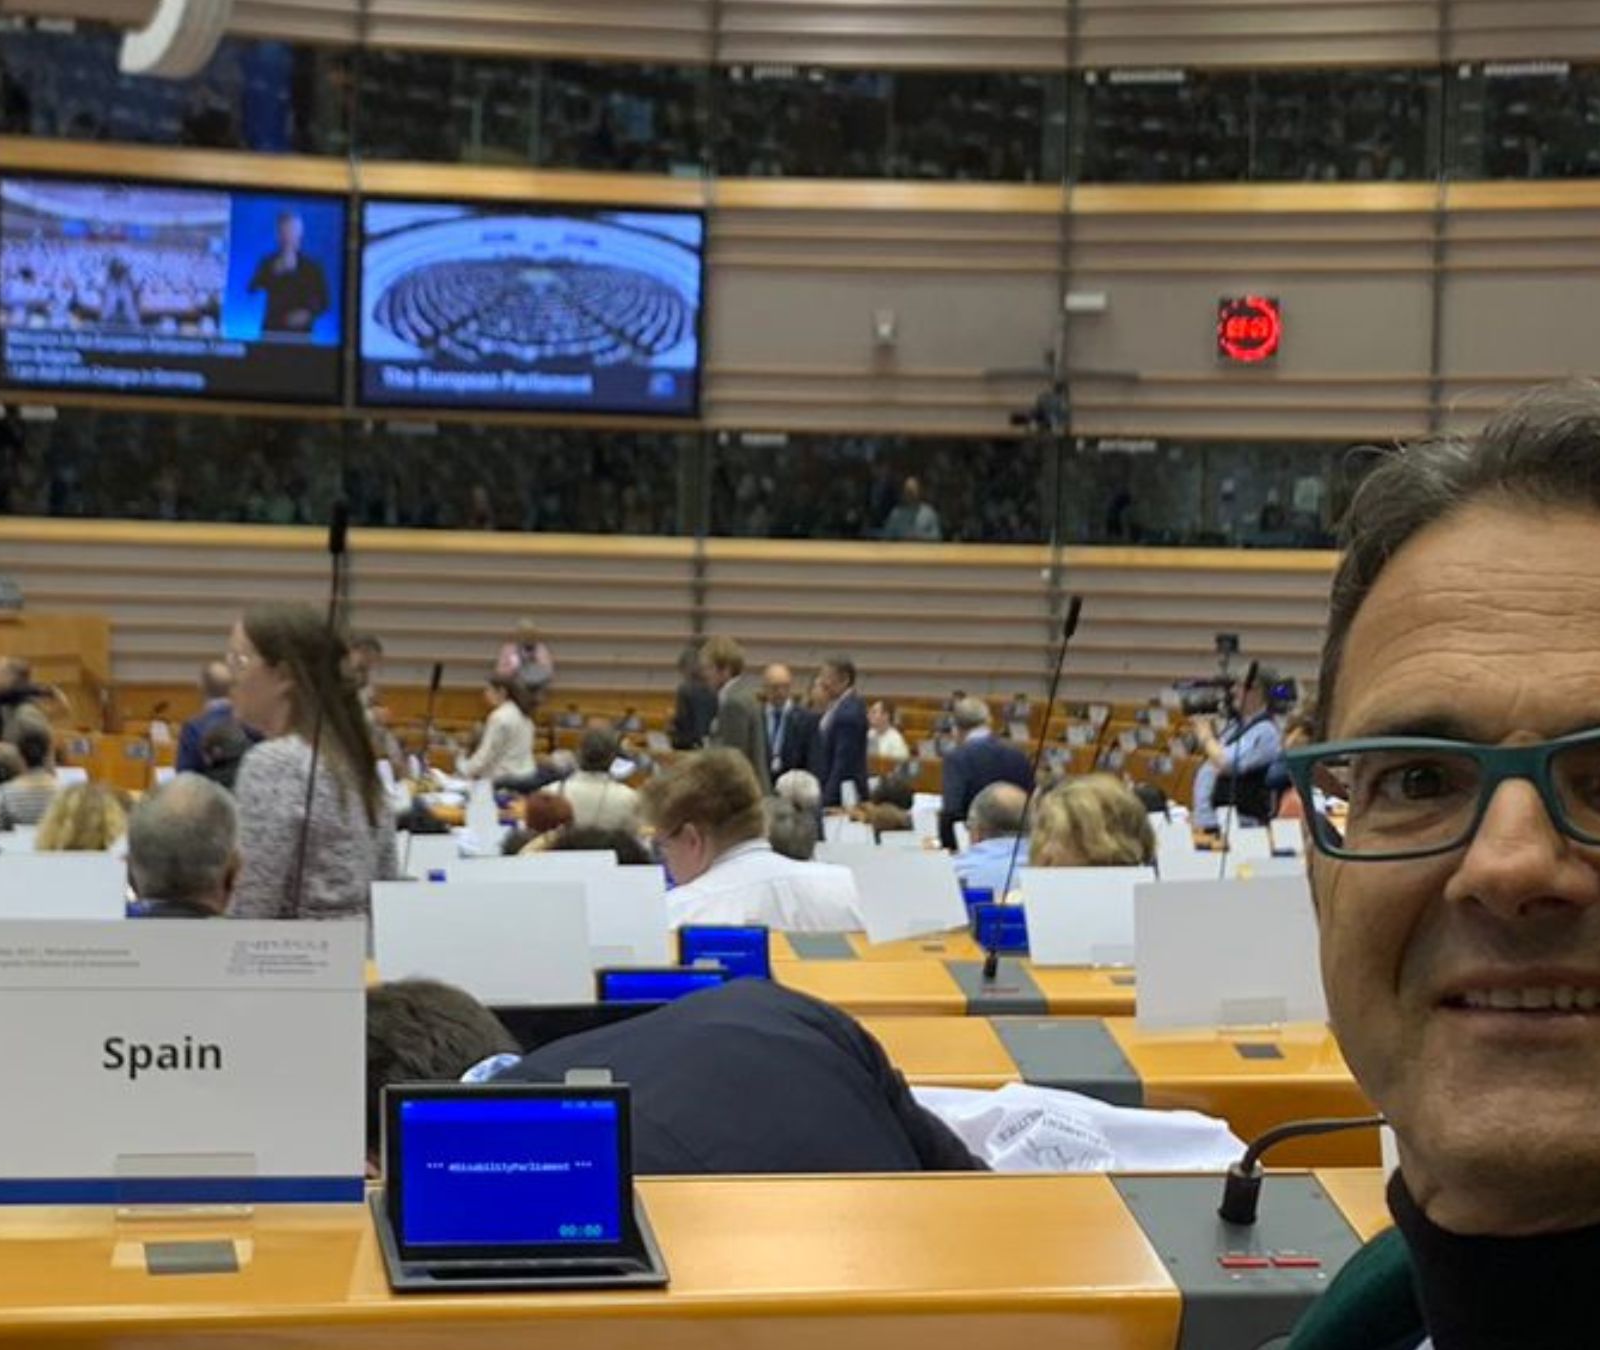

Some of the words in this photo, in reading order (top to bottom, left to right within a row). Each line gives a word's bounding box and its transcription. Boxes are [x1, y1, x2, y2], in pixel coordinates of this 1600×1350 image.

[382, 366, 413, 386] The
[416, 368, 498, 393] European
[501, 370, 593, 393] Parliament
[102, 1035, 222, 1080] Spain
